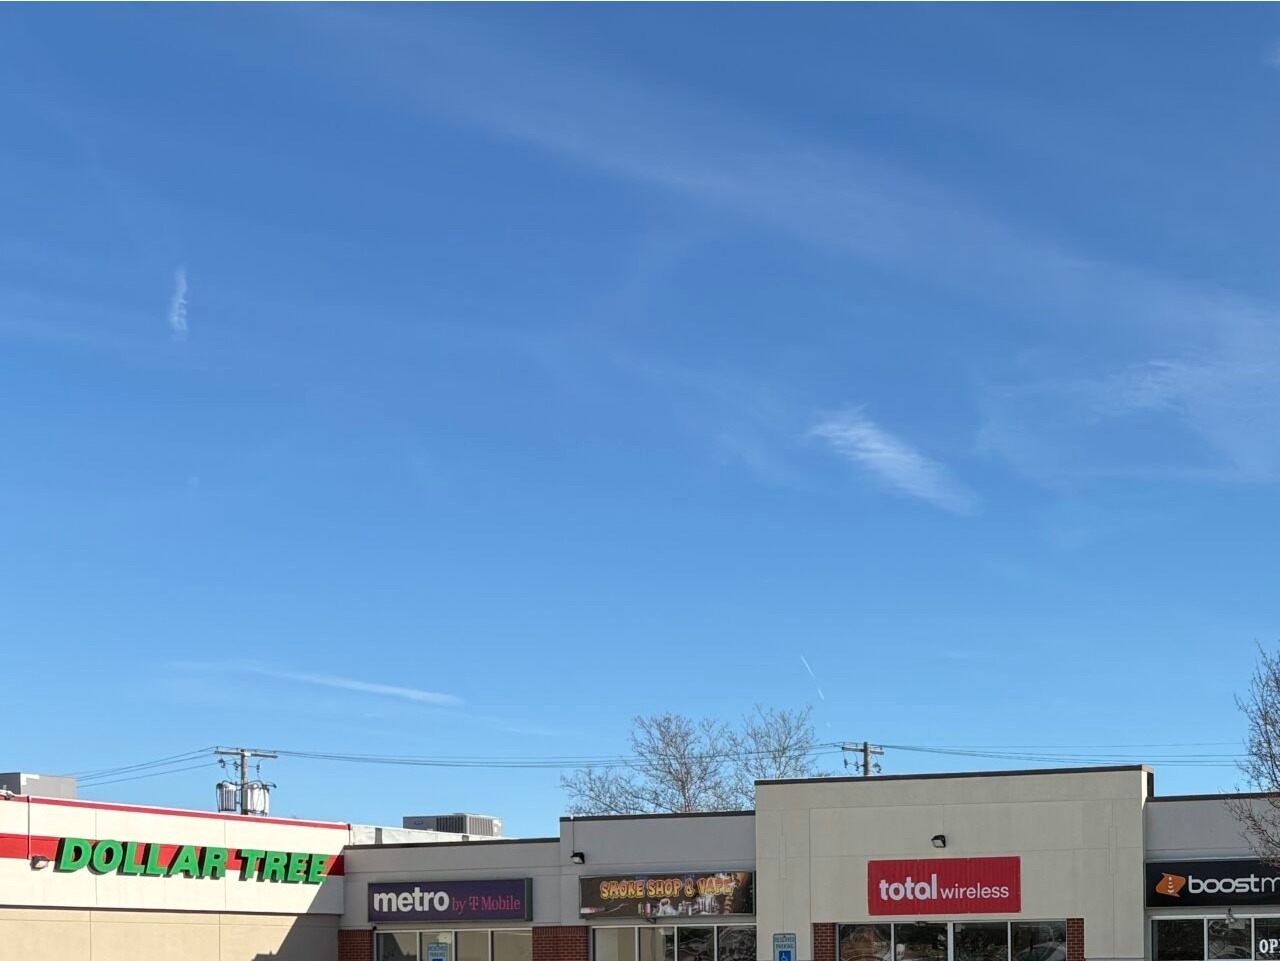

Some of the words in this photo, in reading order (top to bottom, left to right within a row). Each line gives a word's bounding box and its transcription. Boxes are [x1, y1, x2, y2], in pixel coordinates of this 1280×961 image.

[57, 837, 228, 878] DOLLAR
[241, 849, 328, 883] TREE
[373, 886, 450, 912] metro
[452, 897, 467, 915] by
[481, 895, 521, 911] Mobile
[600, 879, 645, 899] SMOKE
[647, 878, 682, 898] SHOP
[684, 878, 695, 897] &
[697, 876, 734, 896] VAPE
[879, 874, 937, 901] total
[940, 883, 1009, 899] wireless
